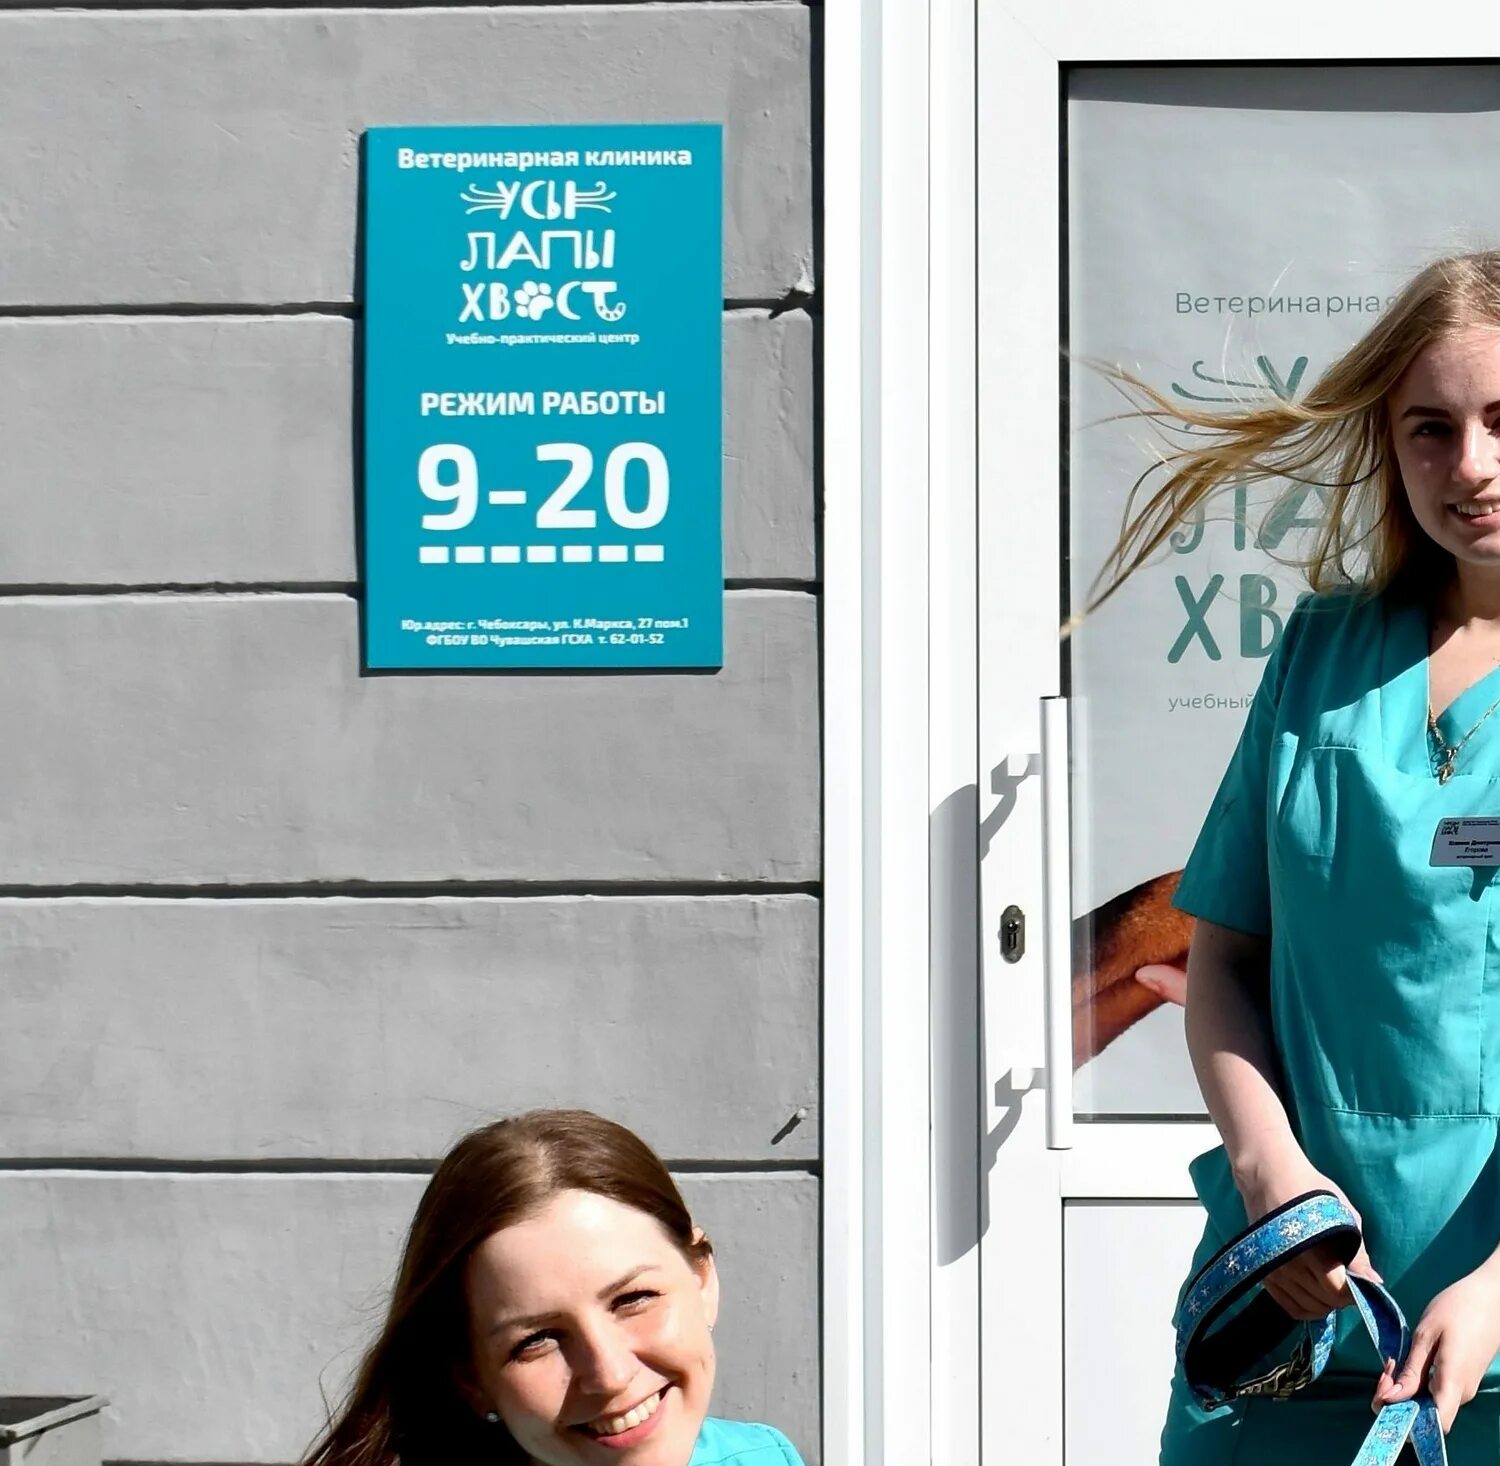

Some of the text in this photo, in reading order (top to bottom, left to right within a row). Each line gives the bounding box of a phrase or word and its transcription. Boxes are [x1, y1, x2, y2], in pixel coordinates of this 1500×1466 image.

[398, 147, 692, 172] Ветеринарная клиника
[460, 229, 615, 272] ЛАПЫ
[445, 333, 640, 346] Учебно-практический центр
[420, 390, 665, 416] РЕЖИМ РАБОТЫ
[418, 441, 670, 531] 9-20
[638, 618, 653, 629] 27
[471, 634, 489, 646] ВО
[490, 634, 560, 648] Чувашская
[561, 634, 593, 645] ГСХА
[609, 633, 665, 645] 62-01-52
